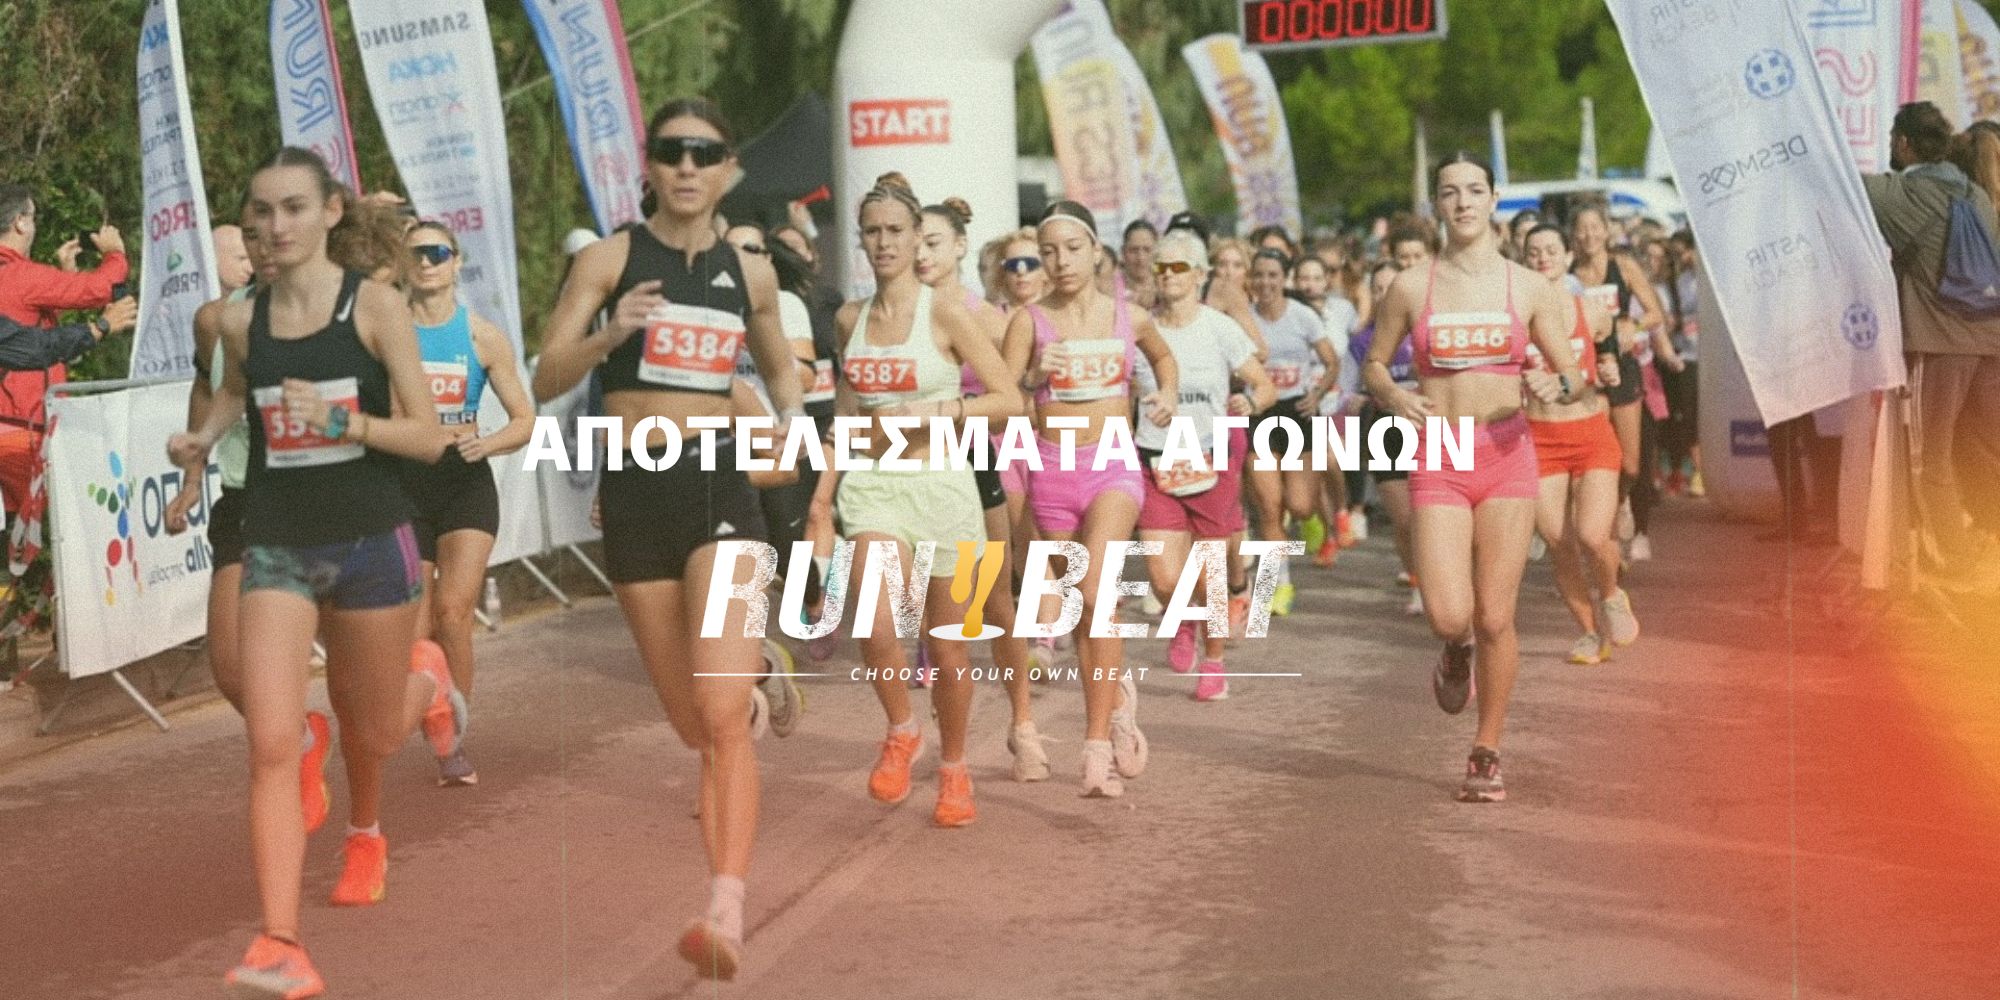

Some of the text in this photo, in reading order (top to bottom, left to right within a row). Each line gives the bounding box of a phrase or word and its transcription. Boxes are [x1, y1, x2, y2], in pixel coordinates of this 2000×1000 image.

[853, 107, 949, 138] START
[652, 326, 737, 361] 5384
[1436, 327, 1505, 350] 5846
[850, 361, 912, 385] 5587
[430, 377, 461, 396] 04
